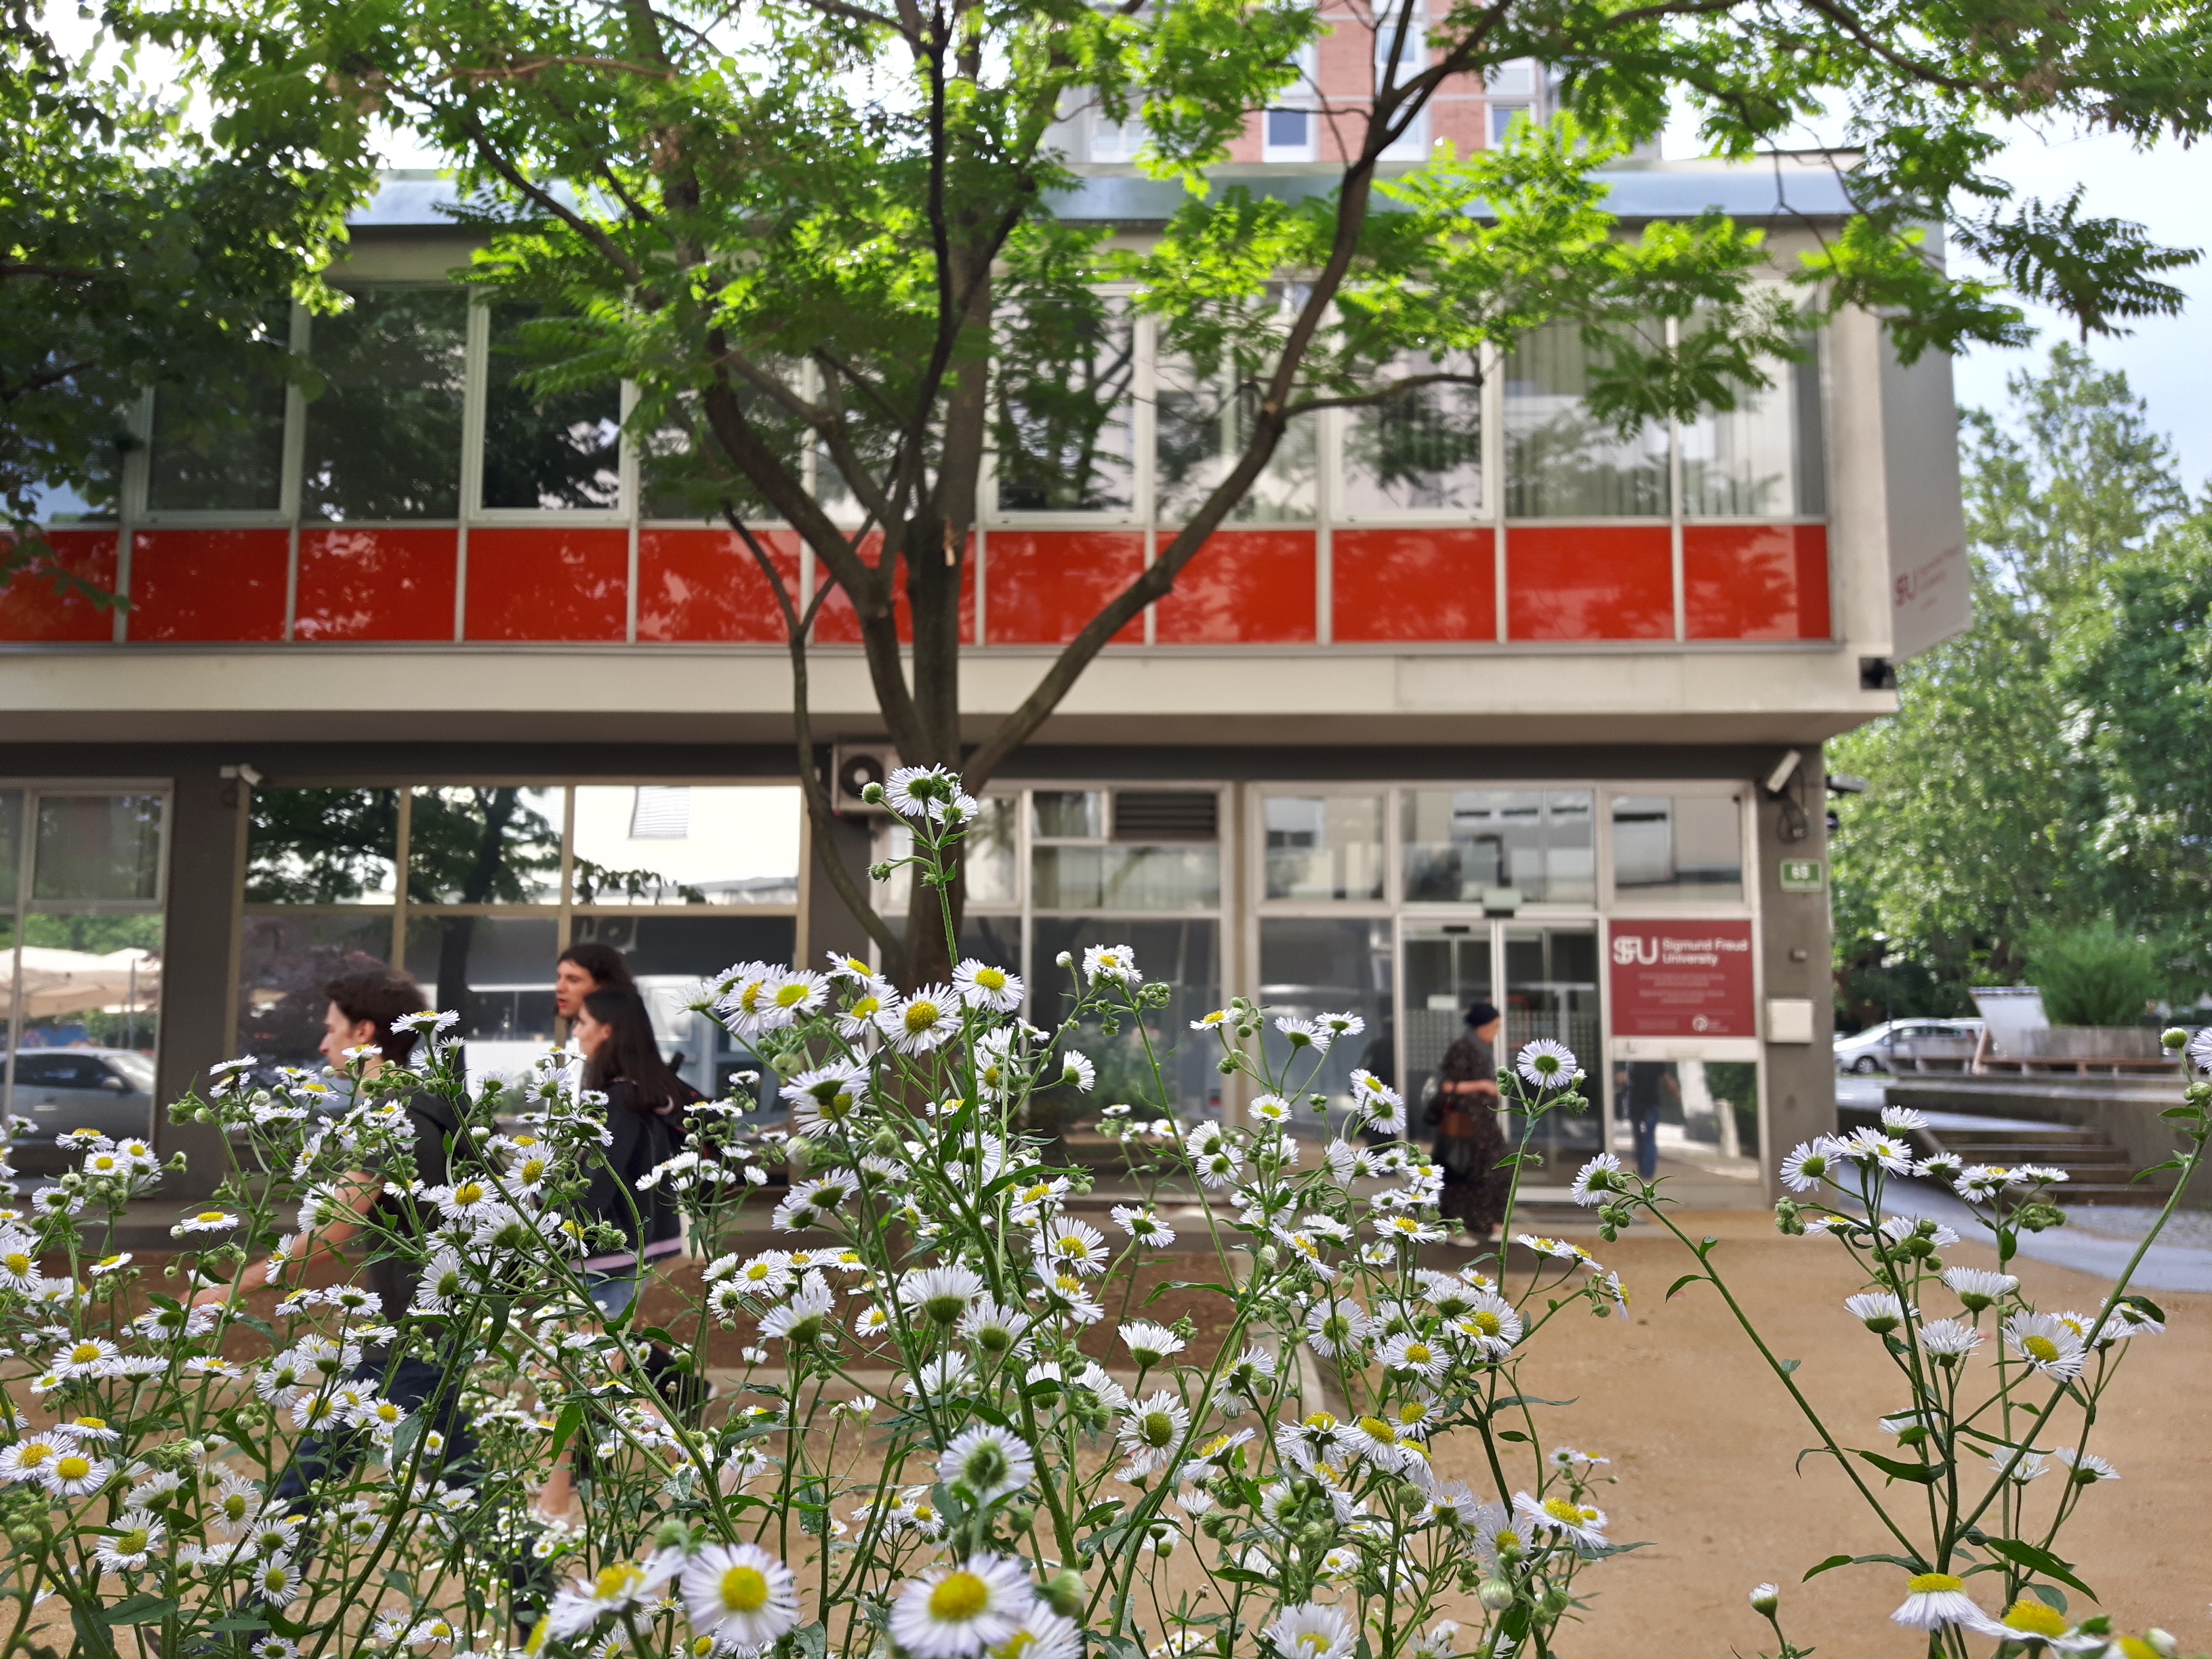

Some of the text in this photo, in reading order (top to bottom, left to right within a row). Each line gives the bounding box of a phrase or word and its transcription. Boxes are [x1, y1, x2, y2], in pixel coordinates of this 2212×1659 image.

[1662, 937, 1748, 953] Sigmund Freud
[1662, 953, 1719, 967] University
